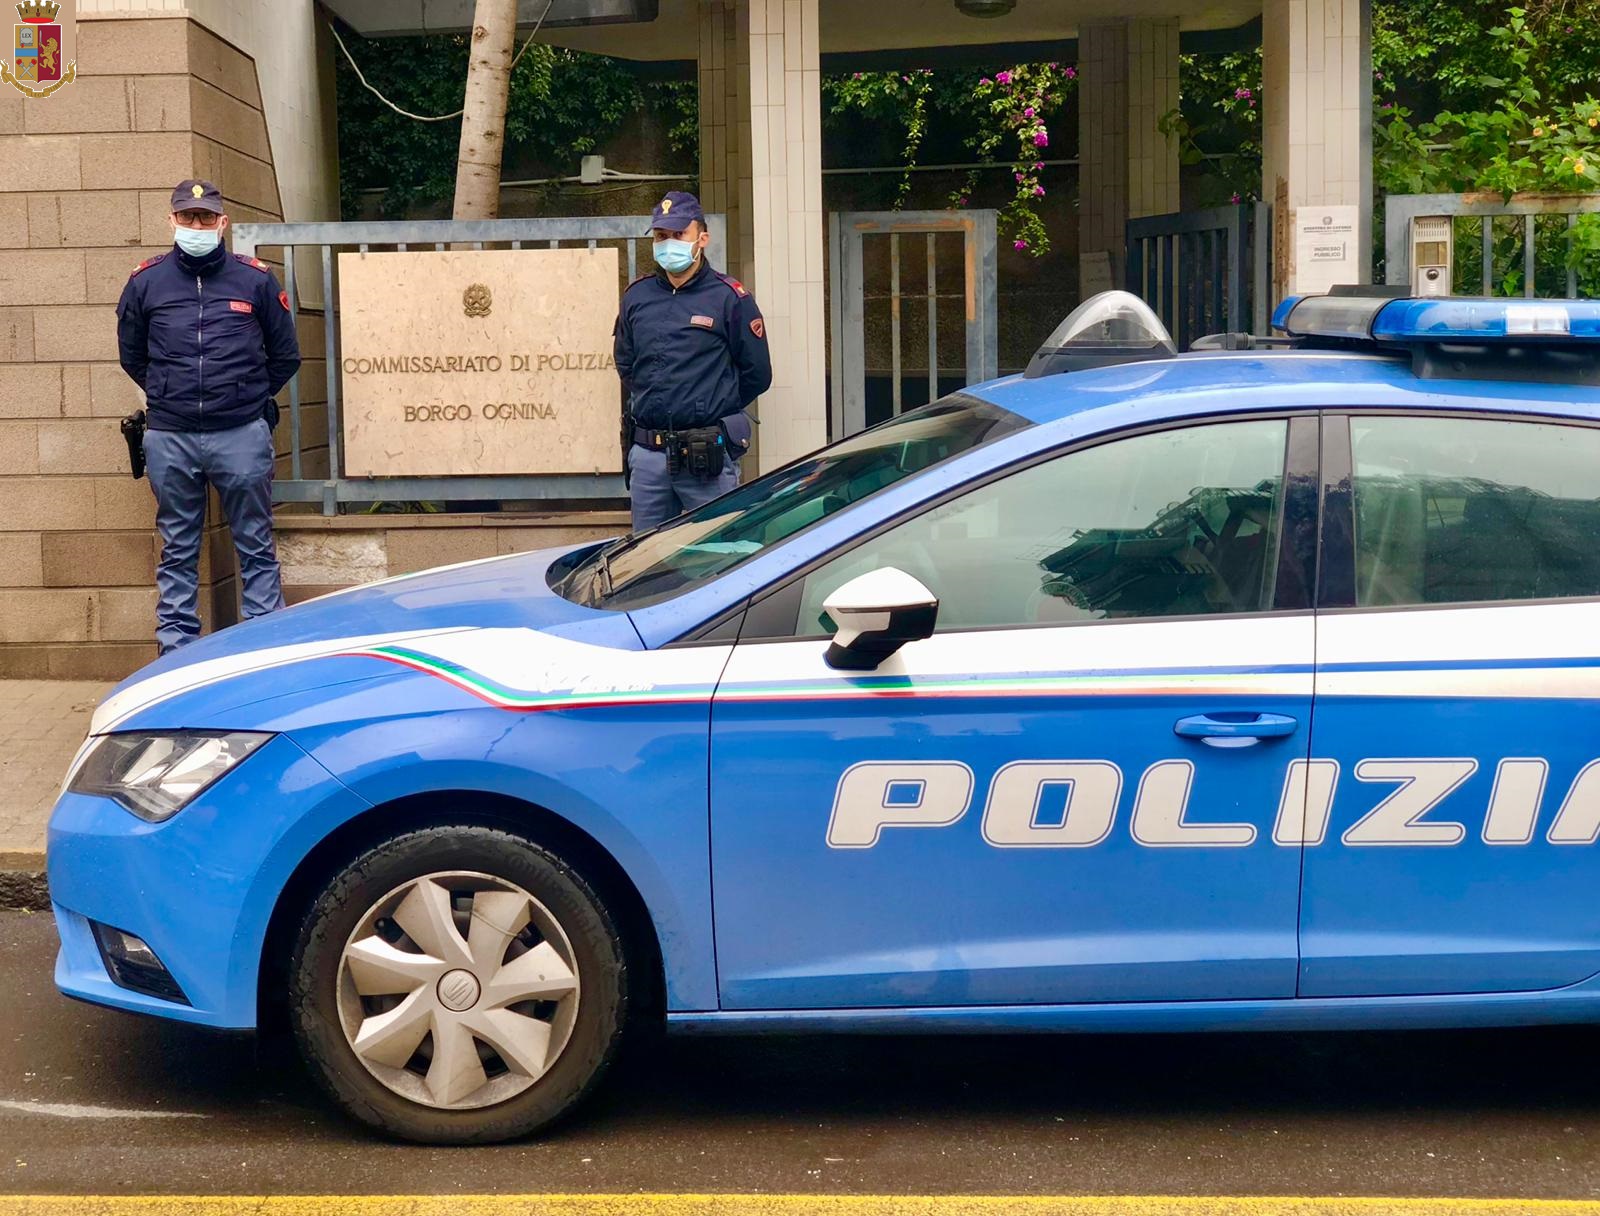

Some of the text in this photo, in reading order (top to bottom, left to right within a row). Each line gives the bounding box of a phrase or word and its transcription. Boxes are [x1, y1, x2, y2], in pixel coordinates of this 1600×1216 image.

[343, 353, 617, 375] COMMISSARIATO DI POLIZIA
[403, 403, 556, 422] BORGO OGNINA
